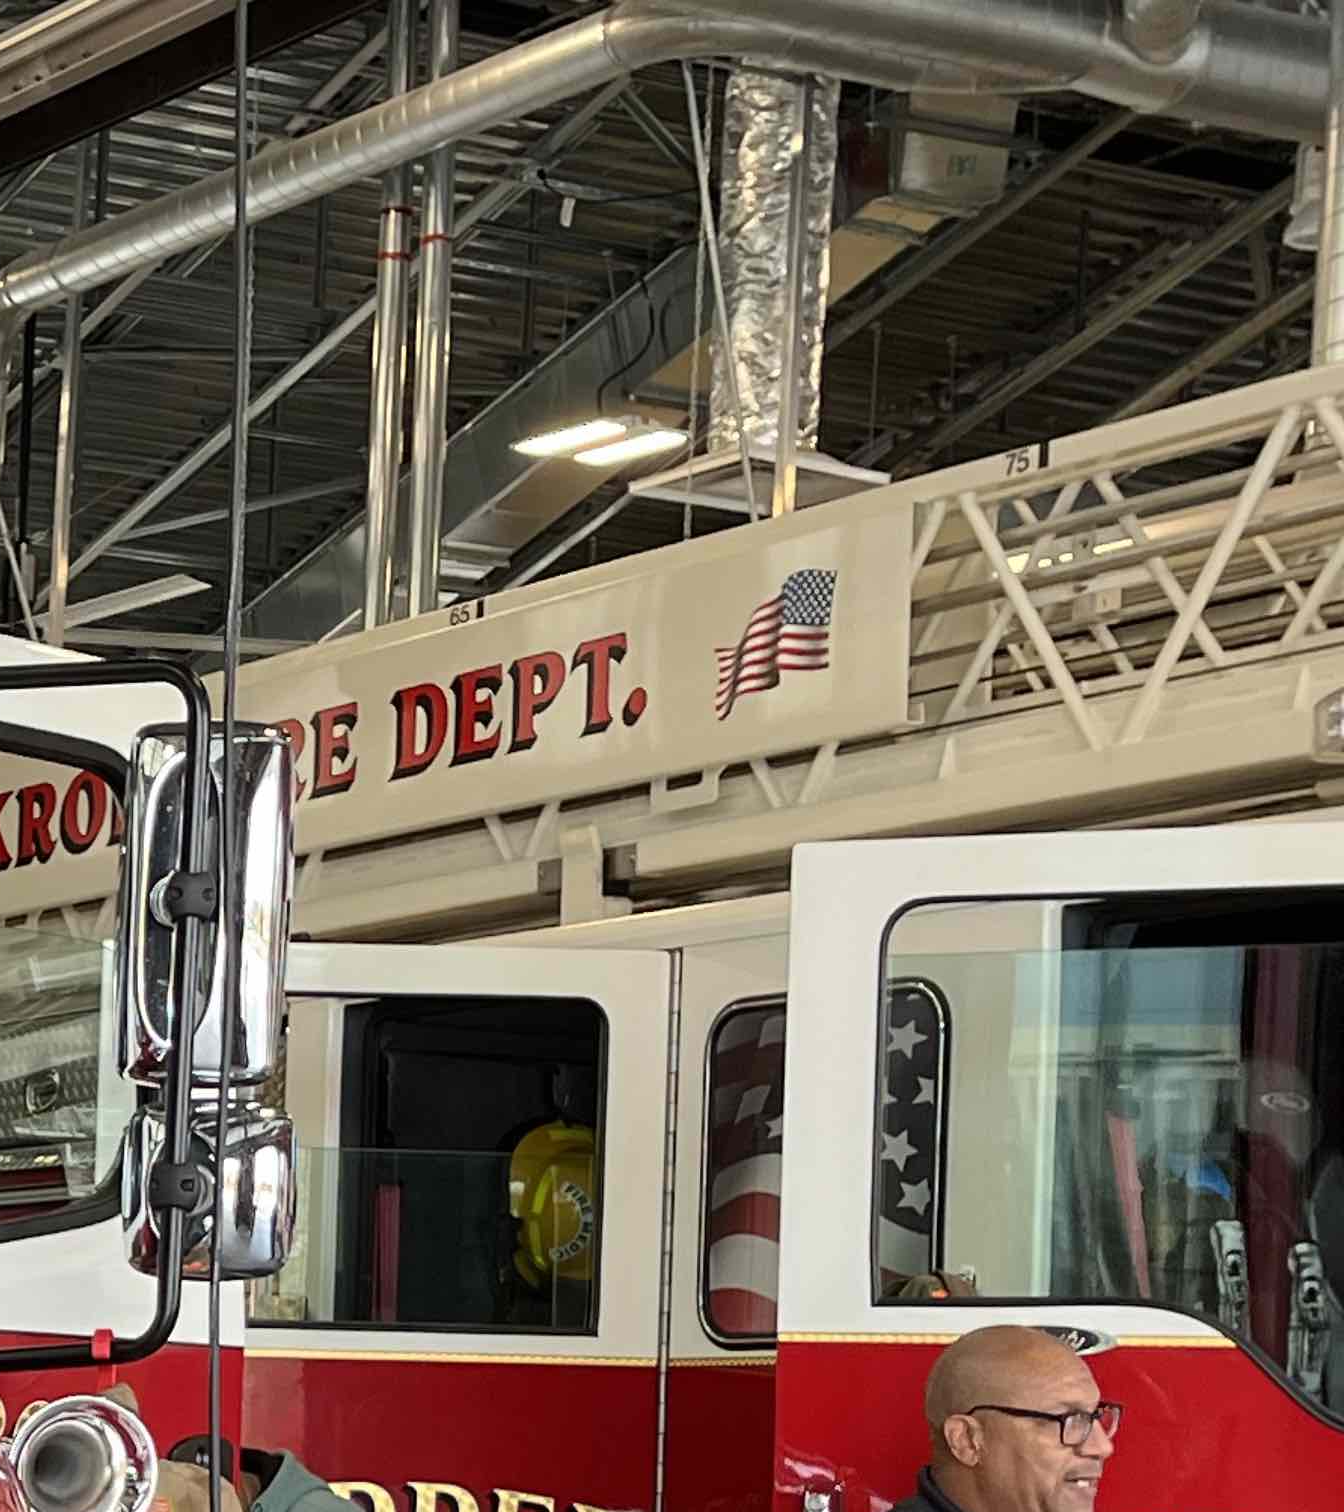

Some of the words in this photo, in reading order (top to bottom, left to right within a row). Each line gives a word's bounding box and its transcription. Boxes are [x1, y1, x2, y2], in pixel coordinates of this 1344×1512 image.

[1005, 448, 1030, 476] 75
[449, 604, 470, 626] 65
[387, 631, 648, 783] DEPT.
